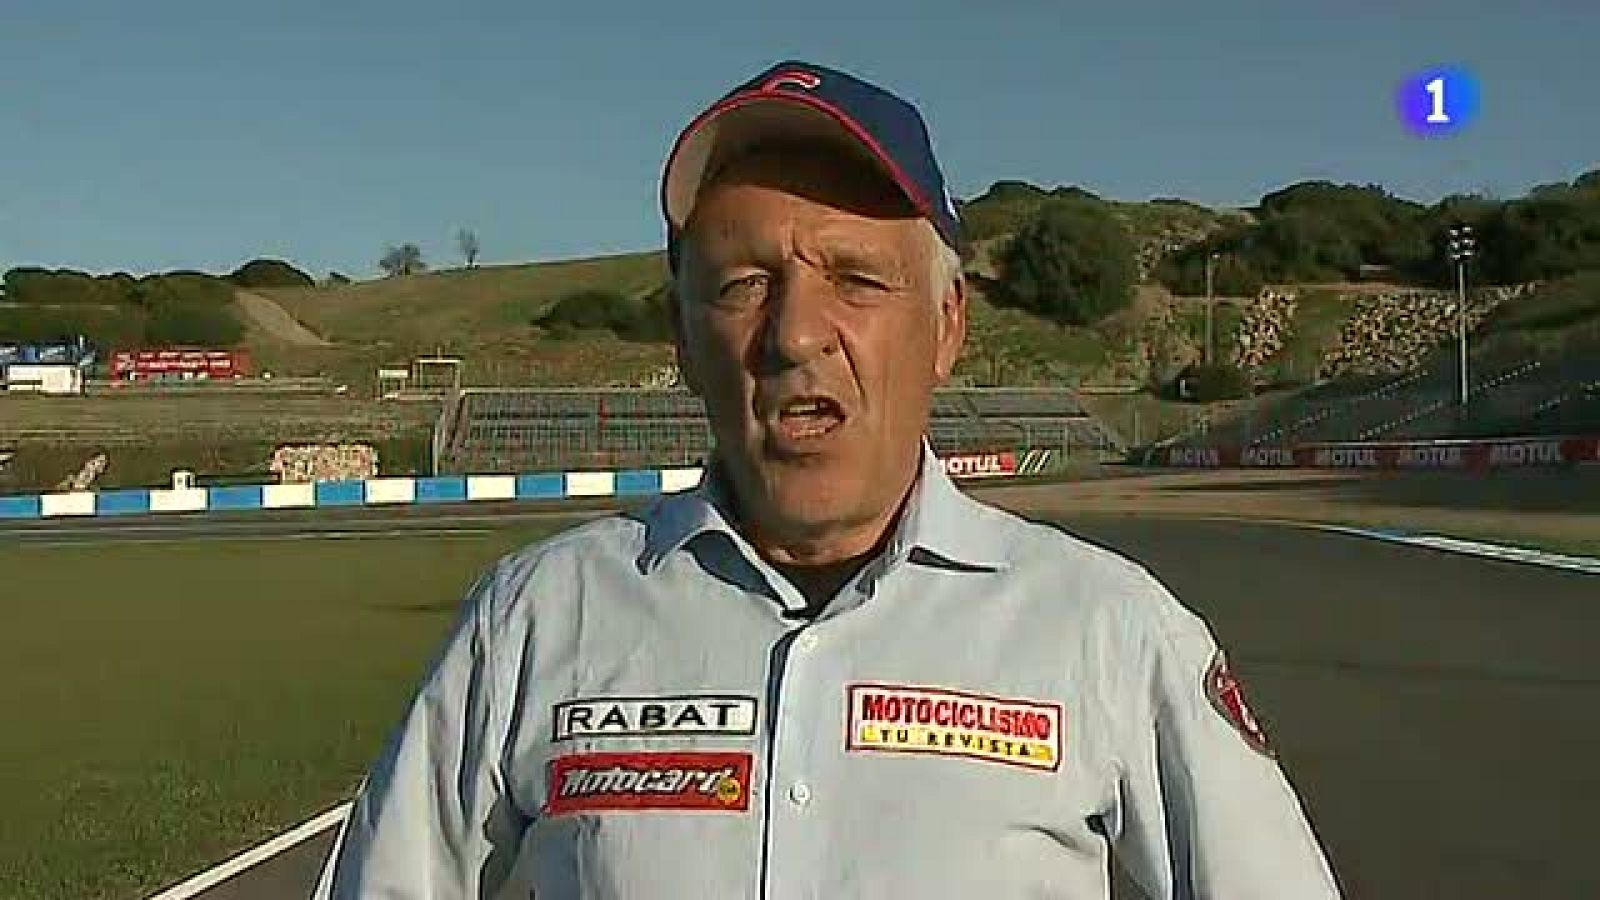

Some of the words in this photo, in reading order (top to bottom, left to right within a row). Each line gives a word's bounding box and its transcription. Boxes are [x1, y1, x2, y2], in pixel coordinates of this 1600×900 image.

[567, 704, 740, 733] RABAT
[862, 694, 1051, 740] MOTOCICLISMO
[880, 728, 908, 743] TU
[927, 731, 1031, 757] REVISTA
